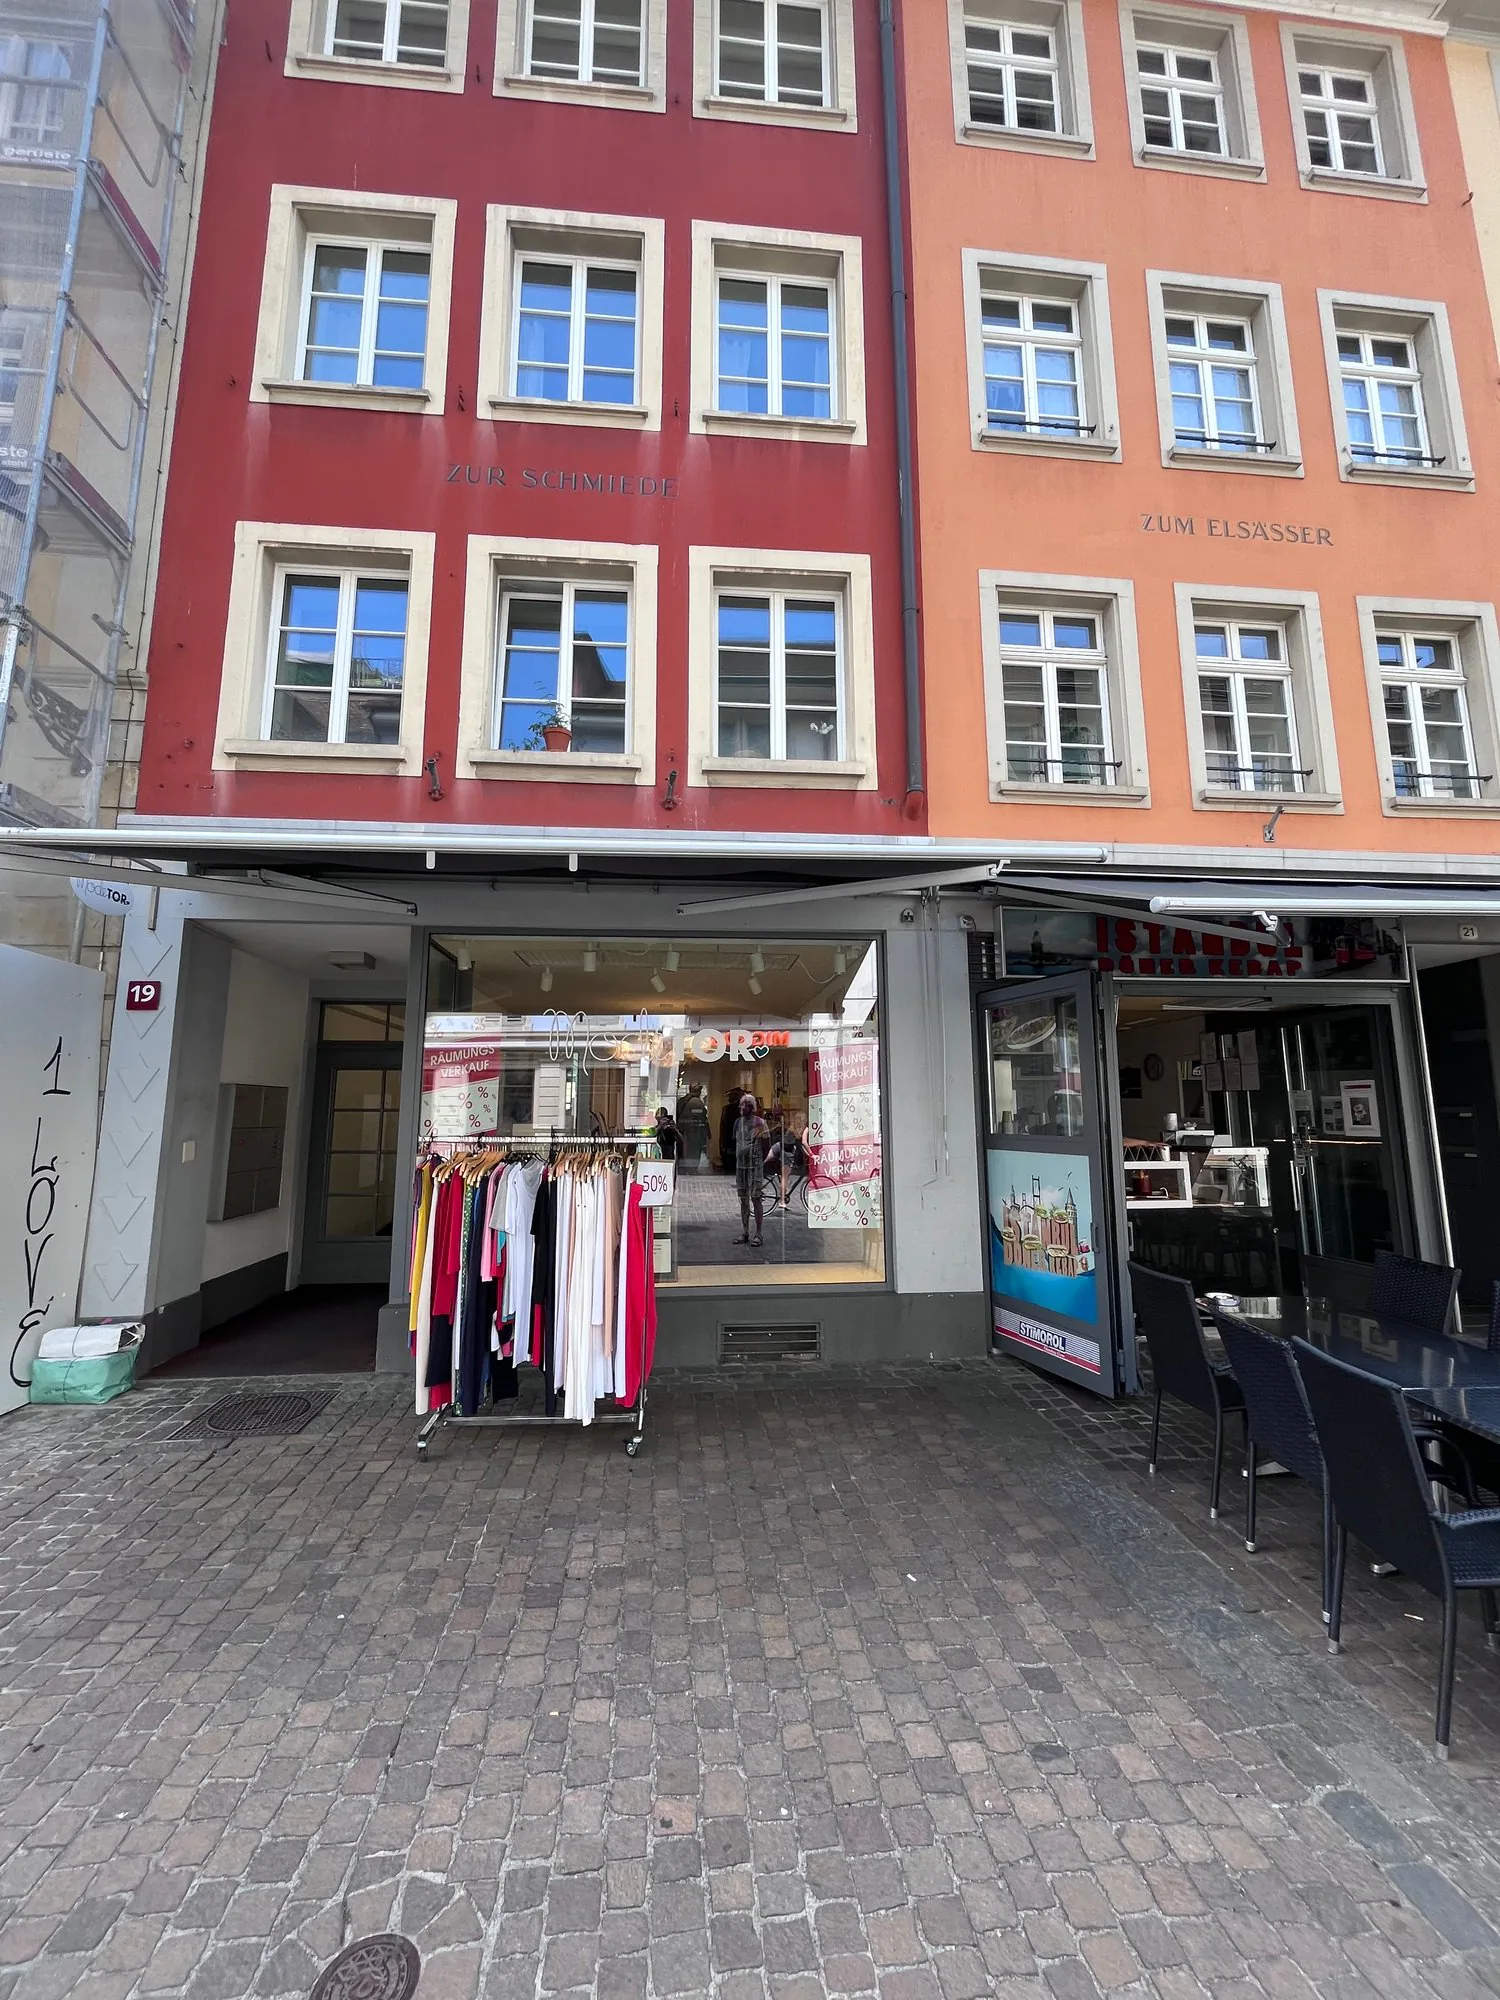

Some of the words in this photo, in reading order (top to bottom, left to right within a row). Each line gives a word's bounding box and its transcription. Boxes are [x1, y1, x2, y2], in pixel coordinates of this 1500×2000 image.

[446, 463, 507, 486] ZUR
[522, 467, 678, 497] SCHMIEDE
[1140, 513, 1196, 536] ZUM
[1206, 518, 1335, 547] ELSÄSSER
[1462, 926, 1475, 937] 21
[1208, 958, 1303, 977] KEBAP
[130, 984, 156, 1003] 19
[43, 1036, 72, 1095] 1
[430, 1046, 495, 1067] RÄUMUNGS
[814, 1050, 873, 1071] RÄUMUNGS
[440, 1059, 490, 1078] VERKAUF
[824, 1066, 869, 1084] VERKAUF
[813, 1144, 874, 1166] RÄUMUNGS
[824, 1162, 870, 1179] VERKAUF
[642, 1175, 668, 1192] 50%
[1020, 1322, 1066, 1351] STIMOROL
